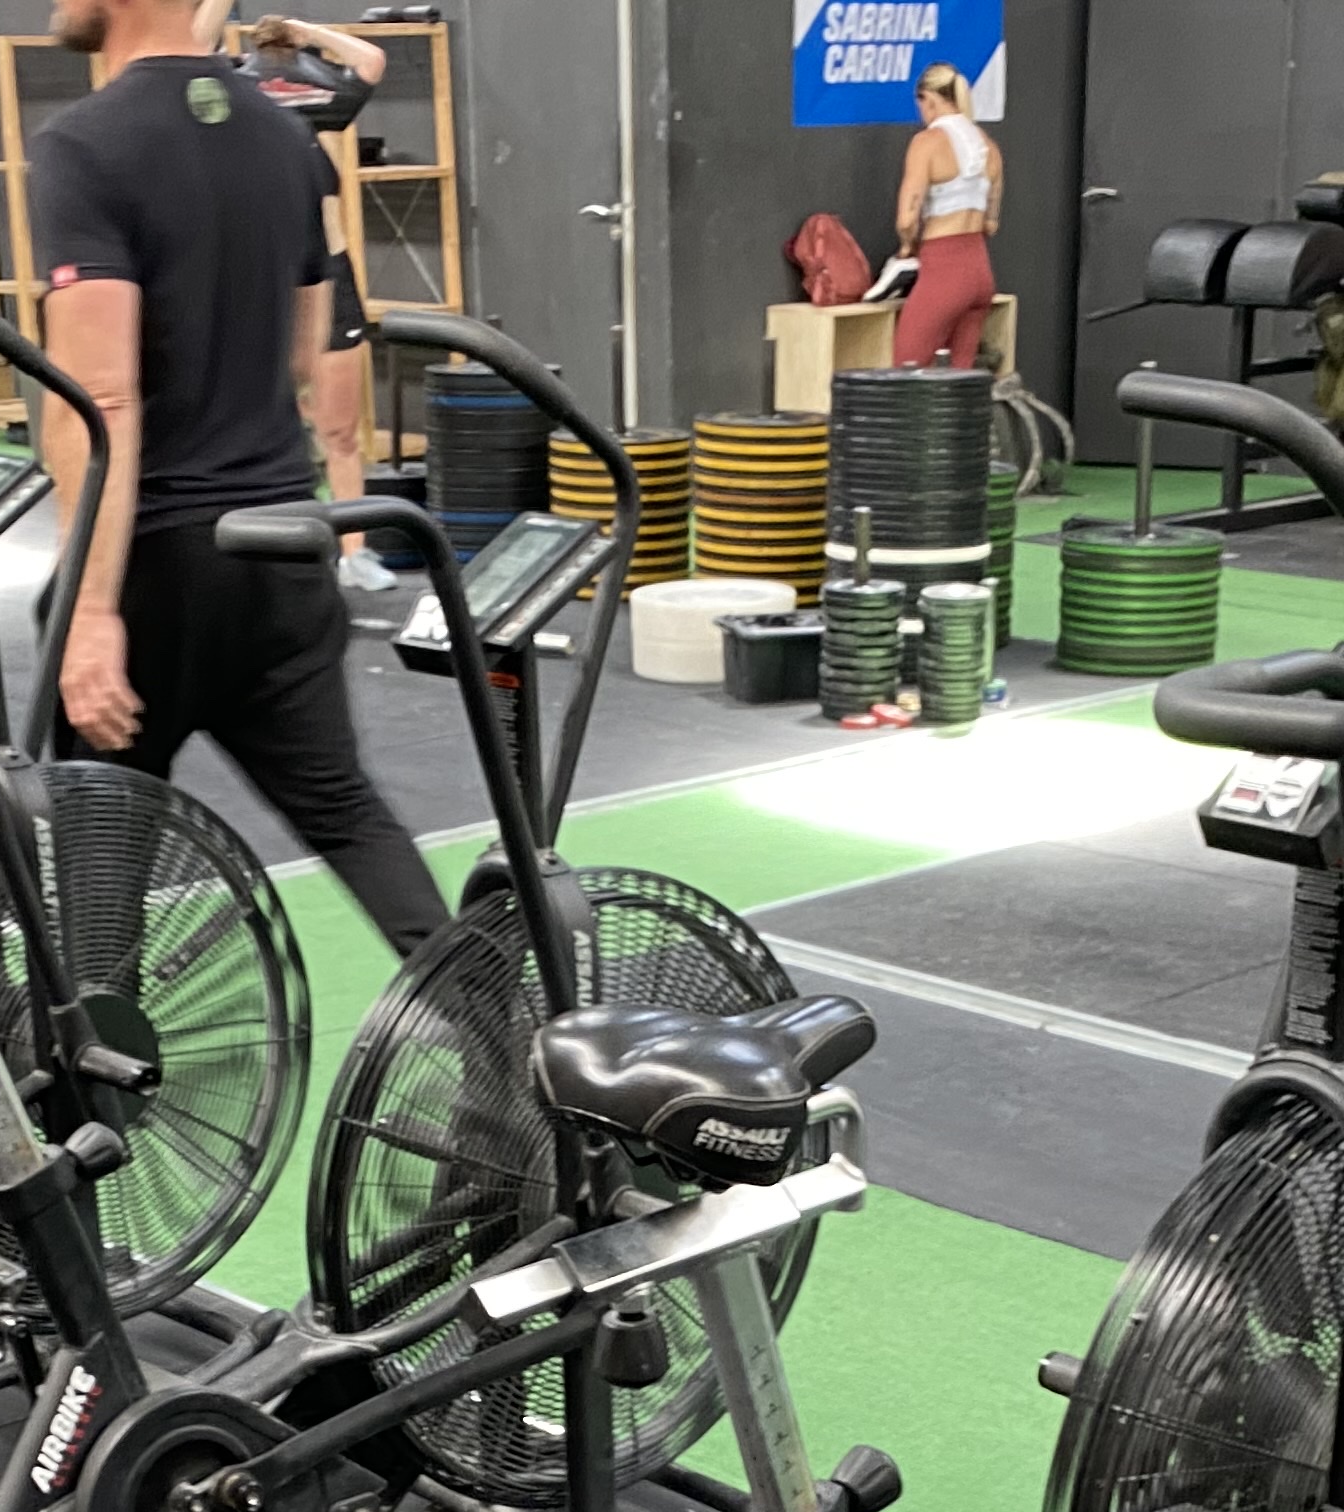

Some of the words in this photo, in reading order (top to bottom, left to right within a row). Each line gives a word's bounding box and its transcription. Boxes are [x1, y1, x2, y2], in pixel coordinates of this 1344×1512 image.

[822, 2, 939, 43] SABRINA
[823, 43, 915, 84] CARON
[692, 1131, 785, 1161] FITNESS
